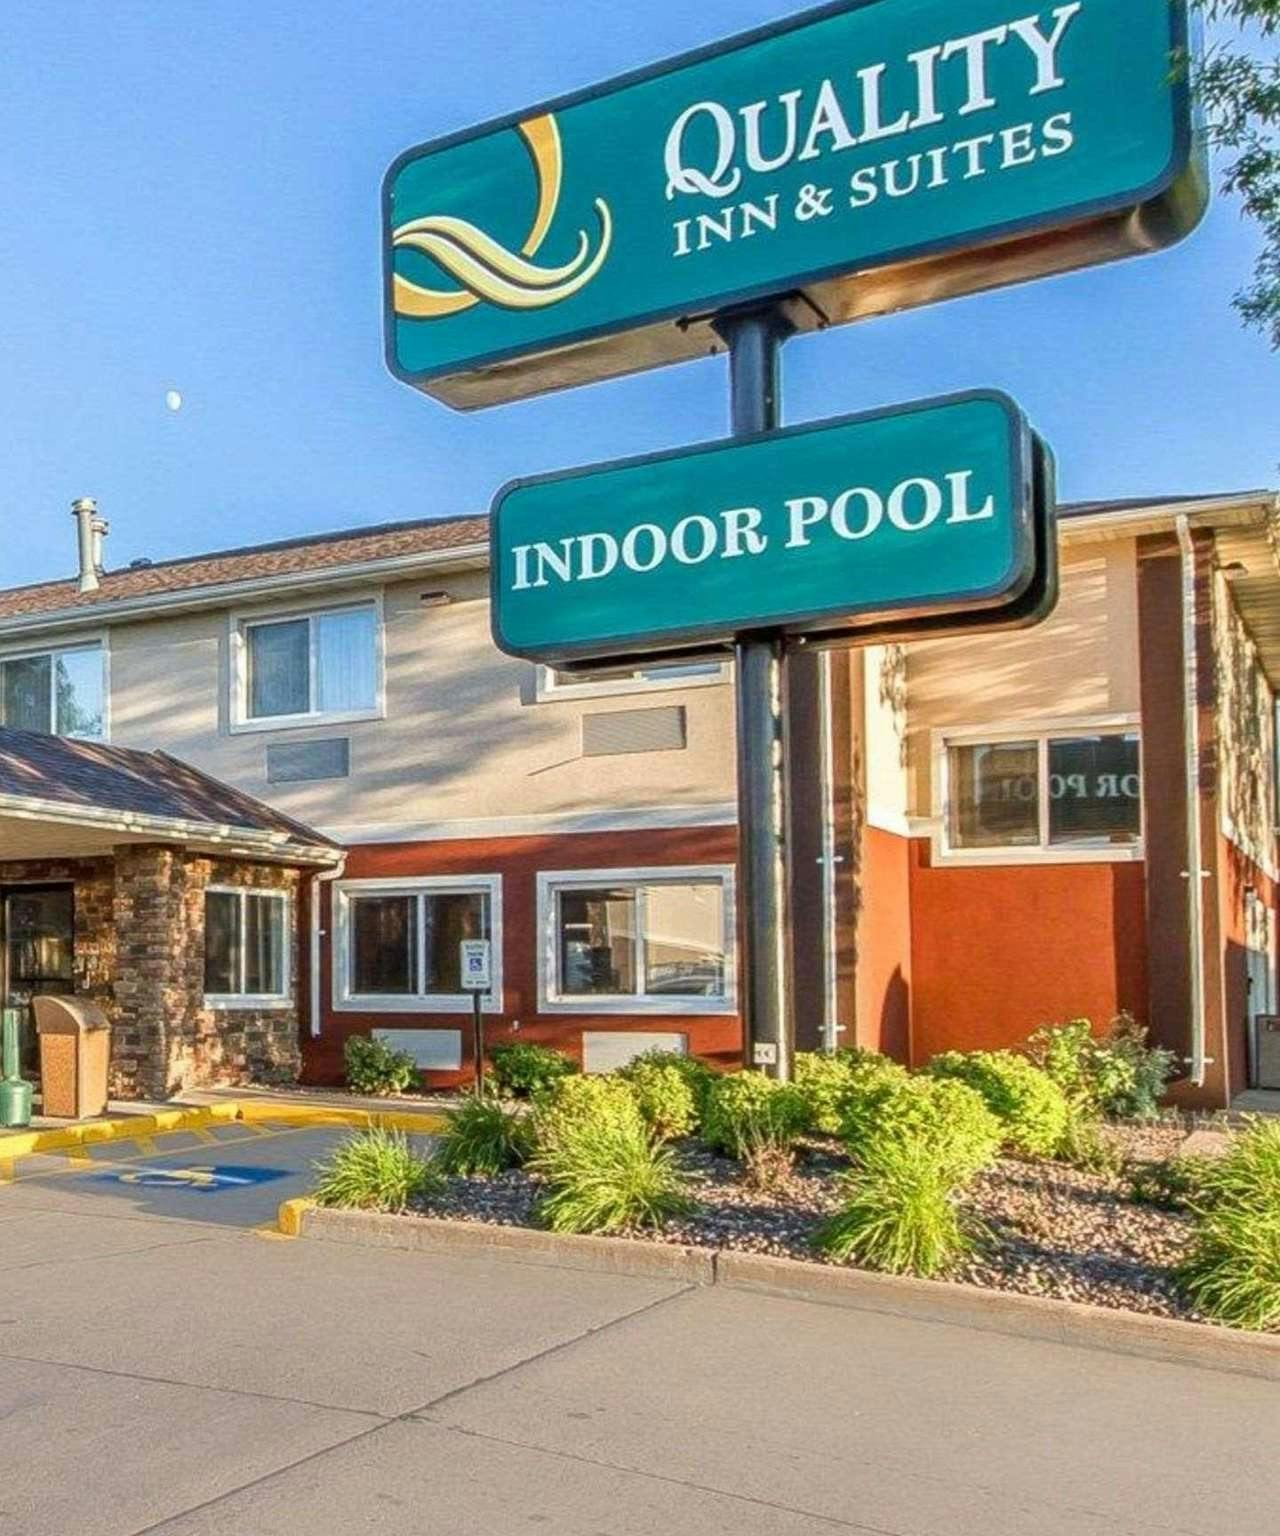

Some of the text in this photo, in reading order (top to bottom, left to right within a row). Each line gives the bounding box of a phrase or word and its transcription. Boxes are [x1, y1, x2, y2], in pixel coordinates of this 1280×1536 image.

[664, 3, 1081, 201] QUALITY
[674, 112, 1075, 256] INN & SUITES
[511, 470, 995, 590] INDOOR POOL
